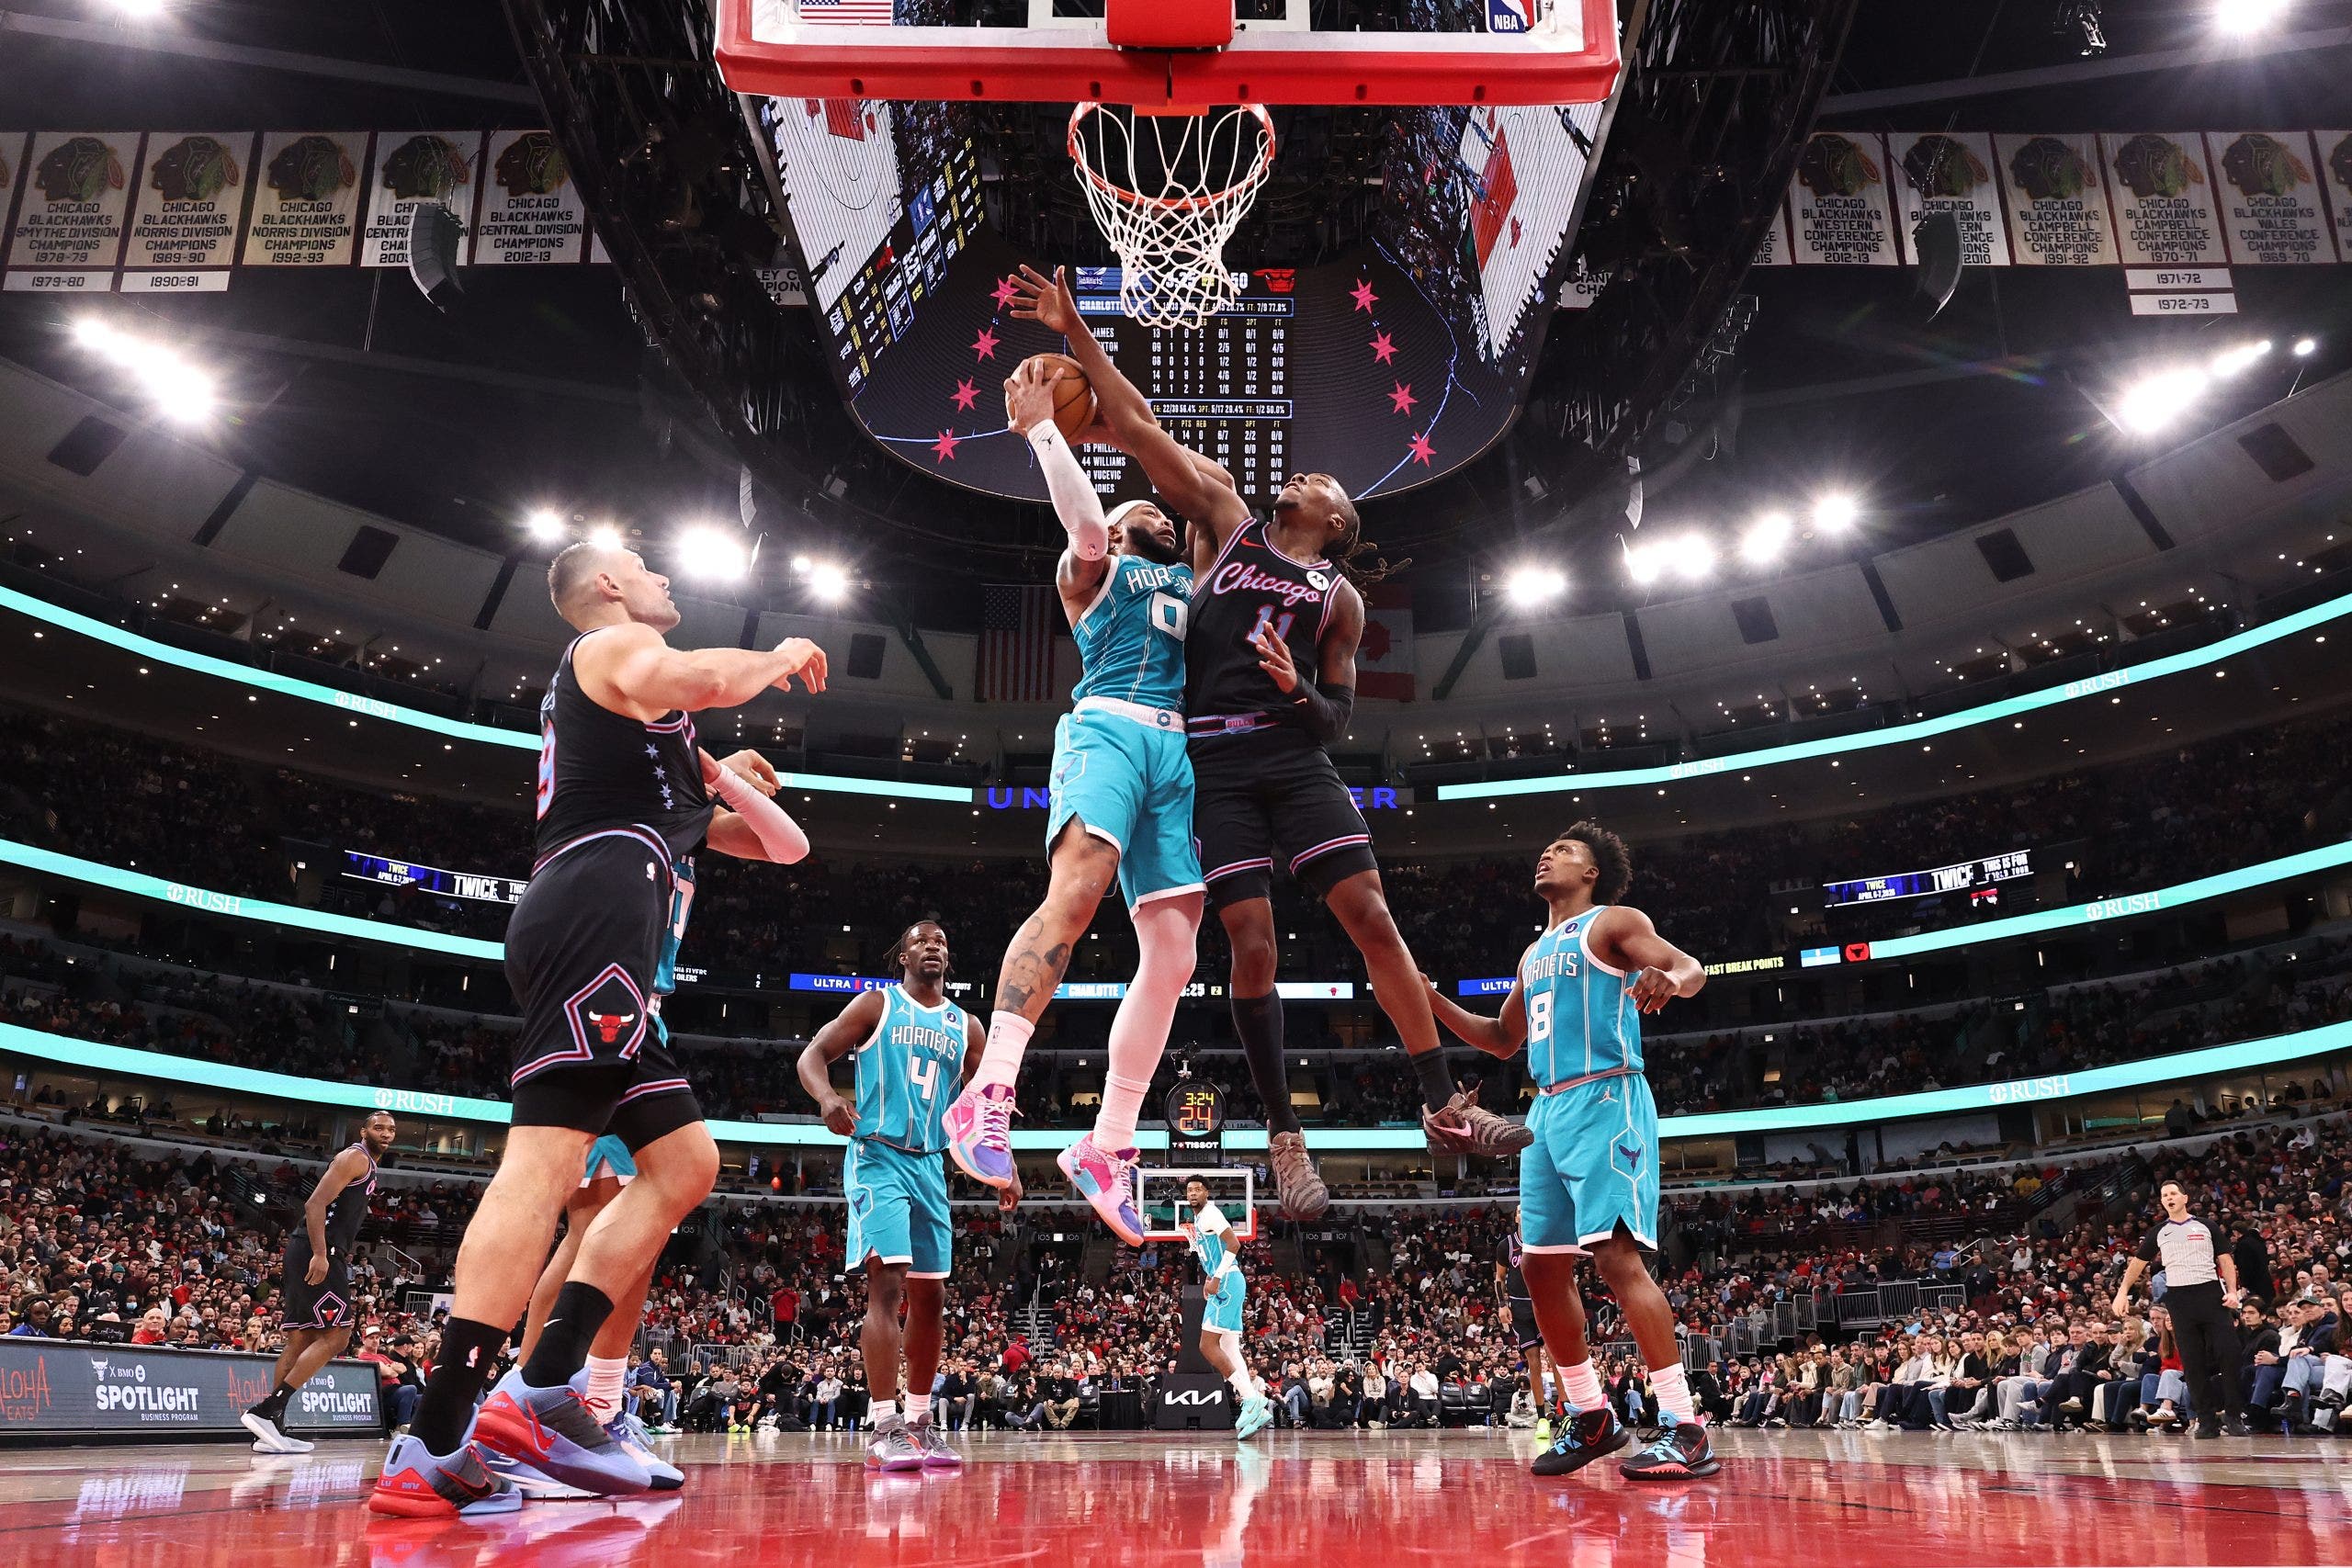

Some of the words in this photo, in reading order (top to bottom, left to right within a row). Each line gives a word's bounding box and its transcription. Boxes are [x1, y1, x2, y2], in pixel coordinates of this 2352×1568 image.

[1494, 15, 1519, 29] NBA
[47, 202, 100, 213] CHICAGO
[162, 202, 215, 213] CHICAGO
[280, 202, 333, 212] CHICAGO
[507, 198, 560, 209] CHICAGO
[1815, 198, 1866, 209] CHICAGO
[1923, 200, 1974, 211] CHICAGO
[2032, 201, 2084, 211] CHICAGO
[2138, 198, 2189, 209] CHICAGO
[2246, 197, 2297, 208] CHICAGO
[490, 211, 573, 222] BLACKHAWKS
[1802, 209, 1883, 220] BLACKHAWKS
[2019, 211, 2099, 221] BLACKHAWKS
[2126, 209, 2206, 220] BLACKHAWKS
[2233, 208, 2314, 218] BLACKHAWKS
[28, 214, 112, 226] BLACKHAWKS
[143, 214, 227, 225] BLACKHAWKS
[262, 214, 345, 226] BLACKHAWKS
[2258, 220, 2297, 229] WALES
[479, 225, 532, 236] CENTRAL
[535, 224, 582, 234] DIVISION
[1813, 220, 1873, 231] WESTERN
[2030, 222, 2095, 231] CAMPBELL
[2134, 220, 2201, 231] CAMPBELL
[16, 227, 65, 238] SMYTHE
[69, 227, 119, 238] DIVISION
[134, 227, 178, 238] NORRIS
[181, 226, 232, 237] DIVISION
[252, 227, 298, 238] NORRIS
[300, 226, 351, 237] DIVISION
[366, 228, 410, 239] CENTR
[1804, 231, 1884, 242] CONFERENCE
[2024, 232, 2103, 243] CONFERENCE
[2131, 231, 2211, 240] CONFERENCE
[2240, 230, 2320, 240] CONFERENCE
[29, 240, 100, 251] CHAMPIONS
[145, 240, 217, 251] CHAMPIONS
[265, 240, 335, 250] CHAMPIONS
[493, 238, 564, 249] CHAMPIONS
[1811, 242, 1880, 253] CHAMPIONS
[2031, 243, 2099, 254] CHAMPIONS
[2137, 241, 2207, 251] CHAMPIONS
[2247, 241, 2317, 251] CHAMPIONS
[35, 253, 88, 263] 1978-79
[153, 253, 206, 264] 1989-90
[272, 253, 324, 263] 1992-93
[504, 252, 551, 262] 2012-13
[1825, 253, 1869, 263] 2012-13
[2044, 254, 2089, 264] 1991-92
[2151, 252, 2199, 262] 1970-71
[2259, 252, 2311, 263] 1969-70
[31, 276, 85, 288] 1979-80
[1079, 276, 1103, 285] HORNETS
[1230, 272, 1249, 289] 50
[2156, 274, 2201, 284] 1971-72
[2158, 299, 2210, 310] 1972-73
[1091, 327, 1114, 338] JAMES
[1099, 342, 1118, 352] XTON
[1093, 444, 1123, 453] PHILLI
[1081, 457, 1091, 466] 44
[1093, 457, 1125, 466] WILLIAMS
[1093, 470, 1121, 479] VUCEVIC
[1094, 483, 1114, 493] JONES
[1213, 561, 1321, 607] Chicago
[2081, 669, 2130, 693] RUSH
[352, 696, 397, 720] RUSH
[389, 863, 409, 874] TWICE
[1983, 859, 2001, 873] THIS
[2002, 857, 2010, 869] IS
[2011, 853, 2028, 866] FOR
[378, 872, 393, 882] APRIL
[1931, 865, 1973, 891] TWICE
[454, 875, 499, 899] TWICE
[1865, 880, 1886, 890] TWICE
[1859, 890, 1873, 900] APRIL
[186, 887, 241, 915] RUSH
[2104, 892, 2161, 918] RUSH
[1525, 952, 1578, 989] ORNETS
[1704, 964, 1724, 976] FAST
[1725, 961, 1753, 974] BREAK
[1754, 957, 1784, 970] POINTS
[813, 977, 851, 989] ULTRA
[1068, 985, 1119, 997] CHARLOTTE
[1530, 990, 1553, 1044] 8
[891, 1025, 958, 1062] HORNETS
[910, 1055, 938, 1100] 4
[2010, 1075, 2071, 1100] RUSH
[395, 1090, 453, 1114] RUSH
[1185, 1092, 1214, 1106] 3:24
[1179, 1106, 1211, 1131] 24
[1184, 1141, 1219, 1149] TISSOT
[109, 1366, 117, 1377] X
[118, 1369, 134, 1378] BMO
[228, 1366, 272, 1416] ALOHA
[96, 1385, 198, 1411] SPOTLIGHT
[301, 1392, 371, 1413] SPOTLIGHT
[1165, 1390, 1223, 1405] KIA
[7, 1406, 35, 1421] EATS
